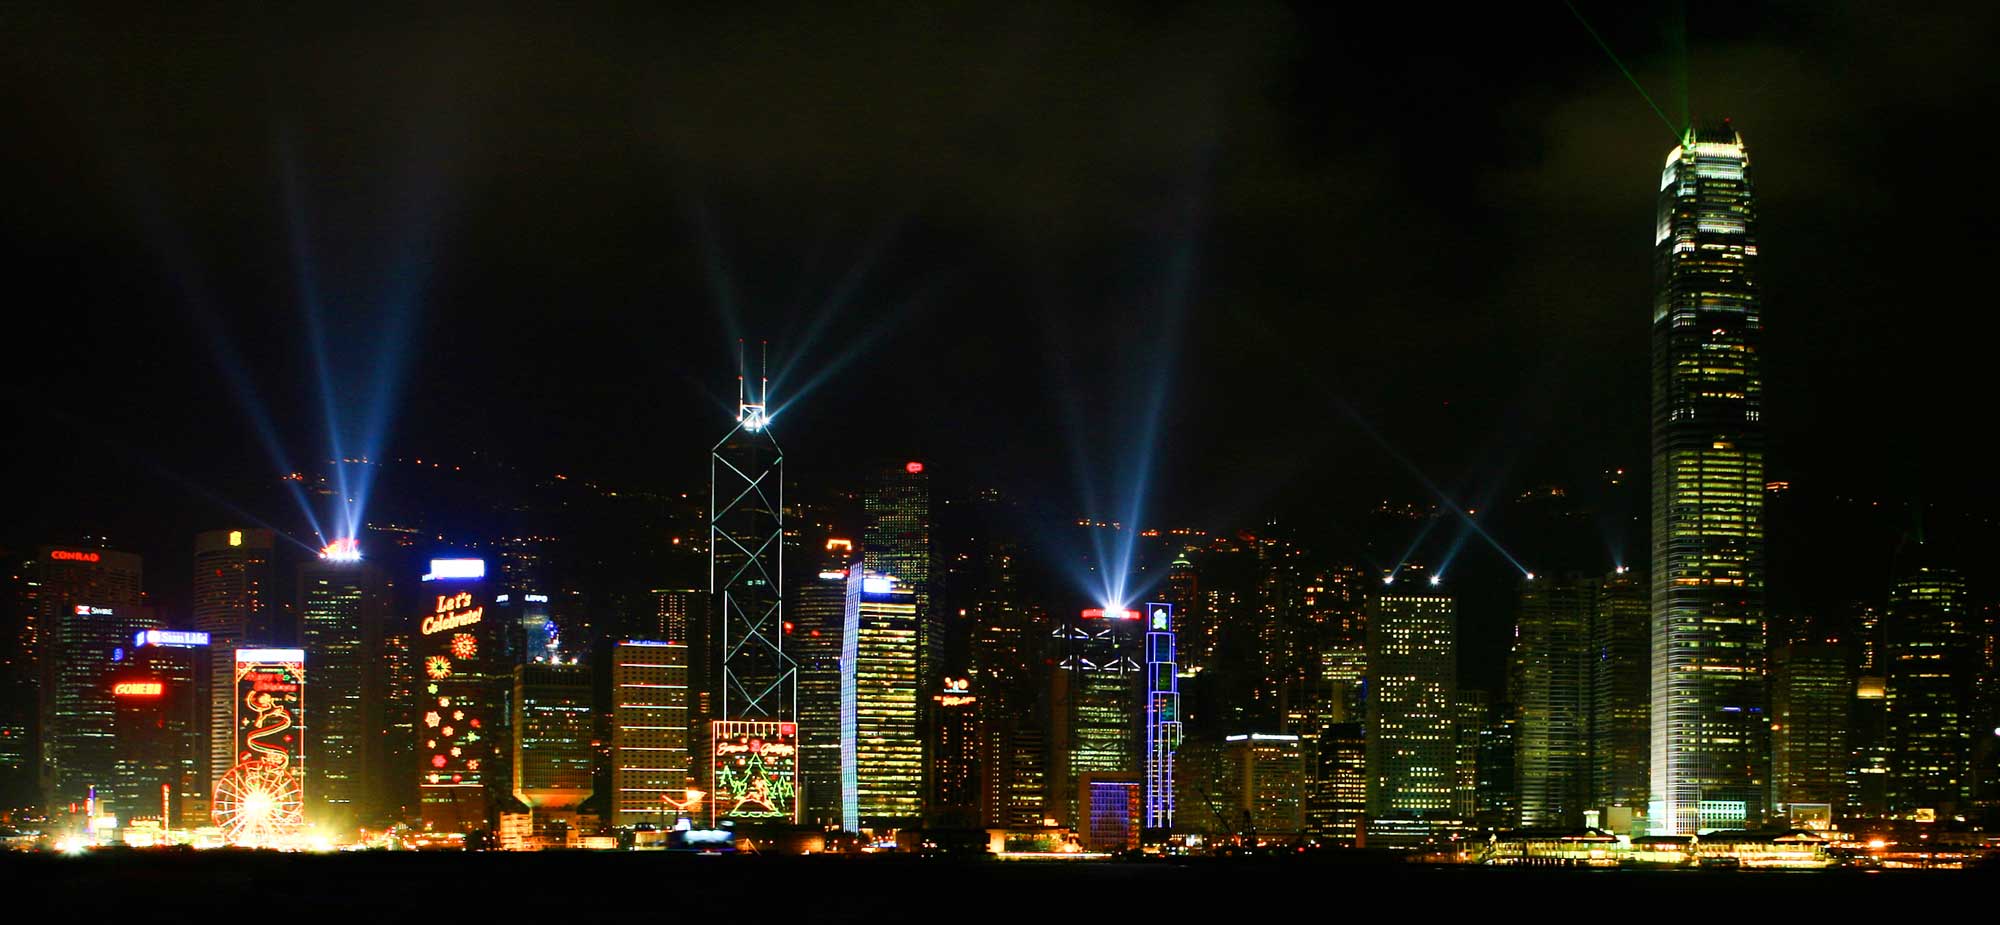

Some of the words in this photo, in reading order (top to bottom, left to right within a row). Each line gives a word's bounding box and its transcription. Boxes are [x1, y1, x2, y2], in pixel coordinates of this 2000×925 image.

[51, 551, 101, 562] CONRAD
[436, 592, 472, 613] Let's
[422, 607, 483, 635] Celebrate!
[160, 632, 184, 644] Sun
